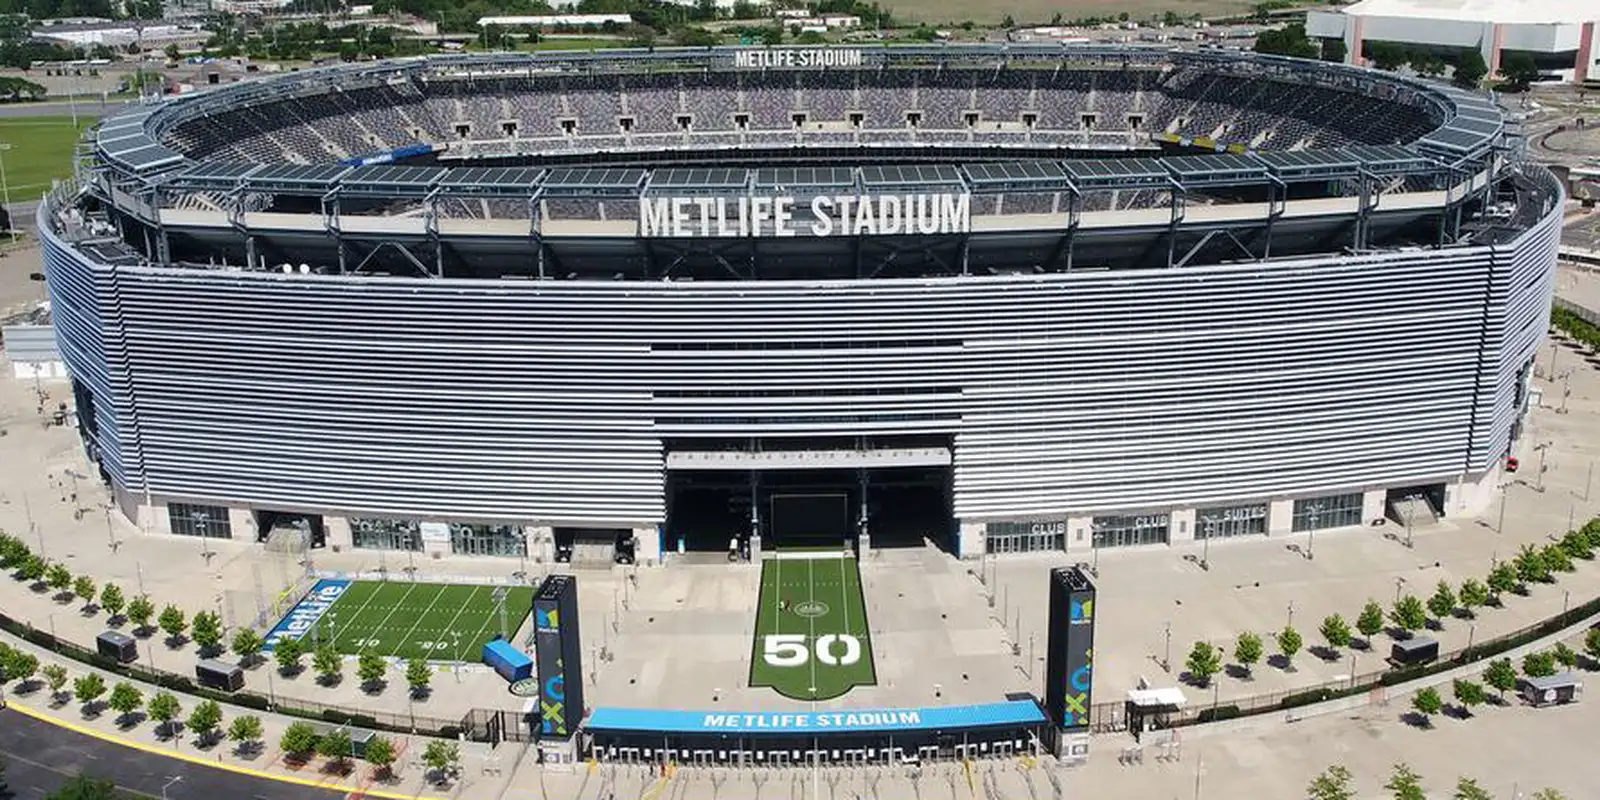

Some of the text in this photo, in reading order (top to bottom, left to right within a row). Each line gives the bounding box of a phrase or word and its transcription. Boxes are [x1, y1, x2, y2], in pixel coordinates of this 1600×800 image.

[735, 49, 861, 67] METLIFE STADIUM
[639, 194, 971, 237] METLIFE STADIUM
[1135, 515, 1169, 528] CLUB
[1224, 506, 1268, 520] SUITES
[1031, 523, 1066, 535] CLUB
[763, 634, 861, 667] 50
[703, 710, 922, 728] METLIFE STADIUM
